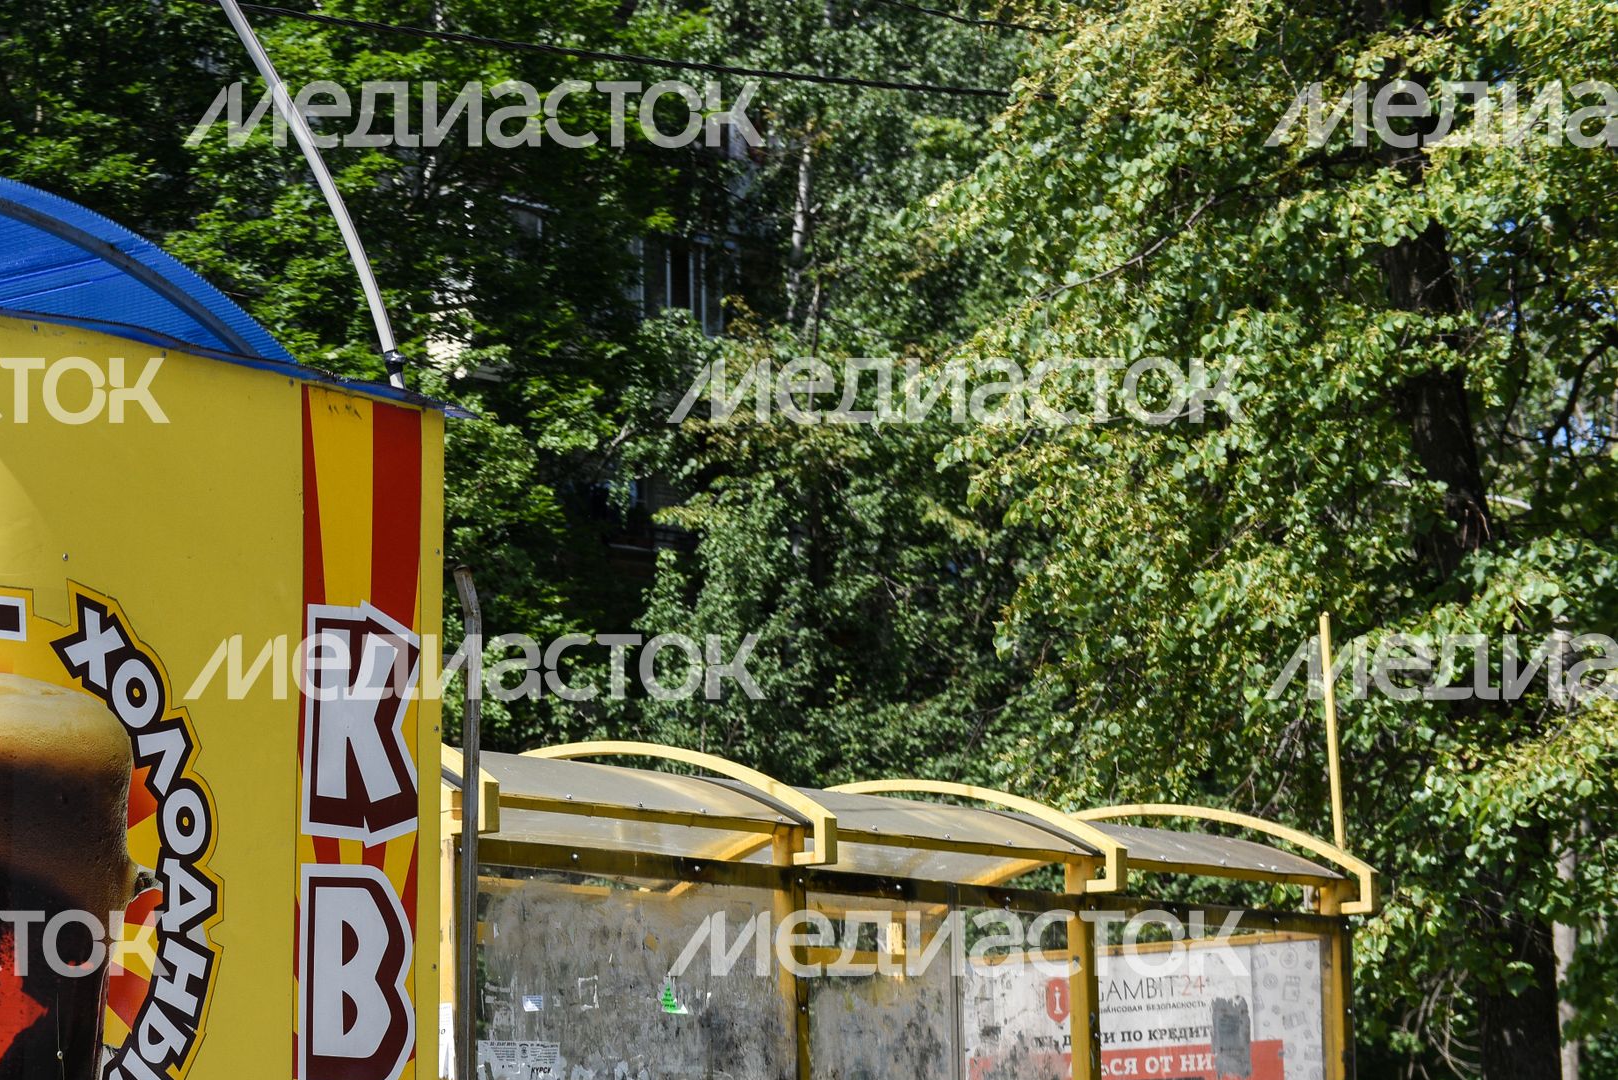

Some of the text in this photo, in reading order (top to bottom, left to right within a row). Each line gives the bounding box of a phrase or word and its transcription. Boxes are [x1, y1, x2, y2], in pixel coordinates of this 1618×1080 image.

[1121, 1031, 1142, 1042] ПО
[1149, 1026, 1212, 1042] КРЕДИТ
[1145, 1056, 1173, 1073] ОТ
[1179, 1053, 1216, 1072] НИ
